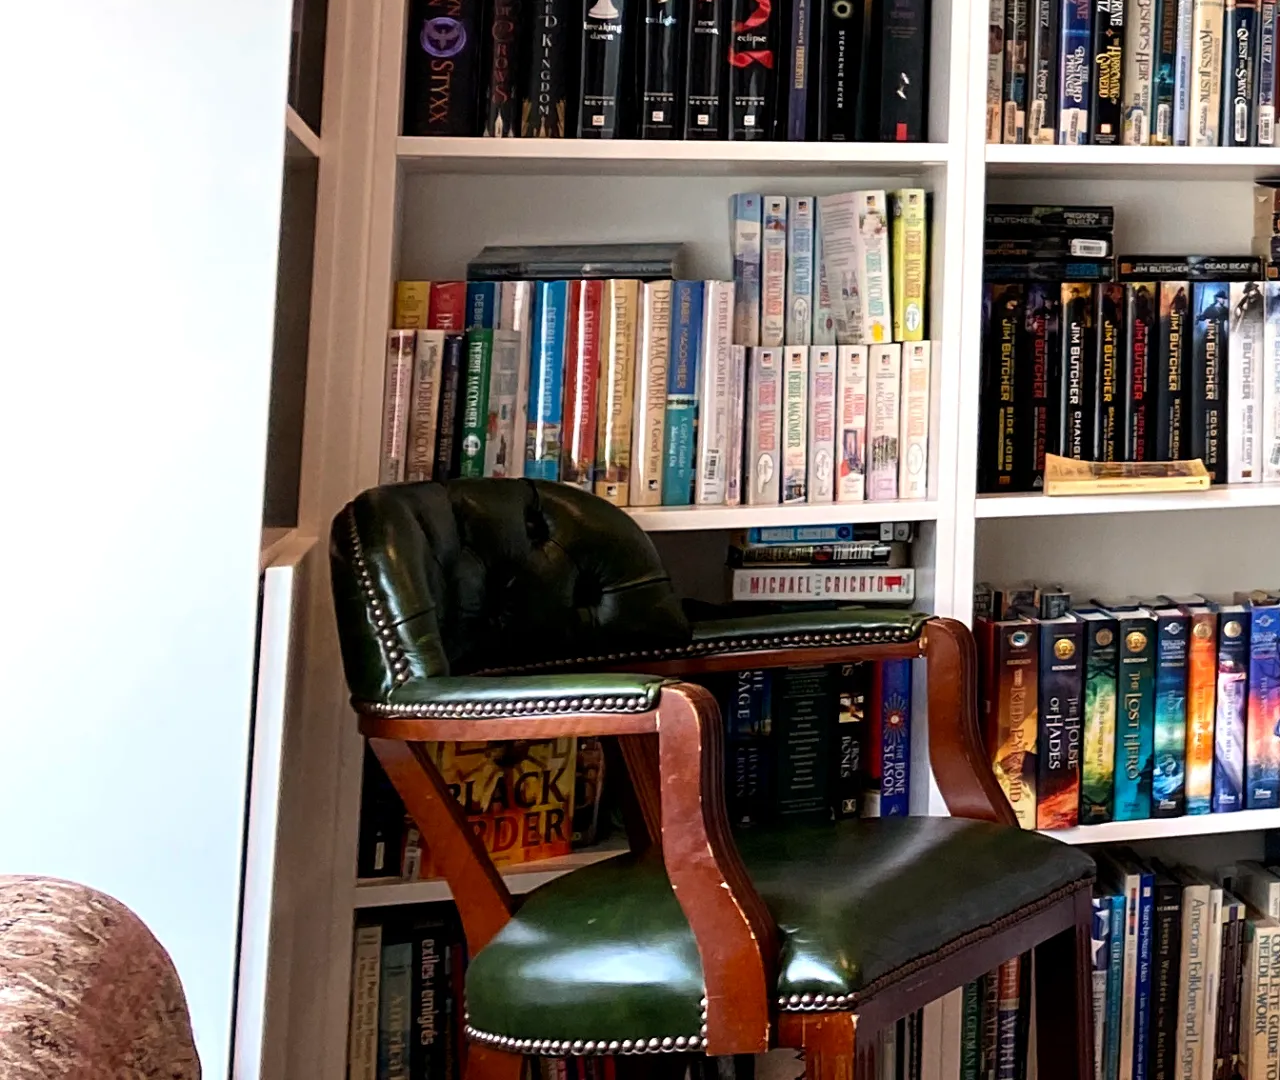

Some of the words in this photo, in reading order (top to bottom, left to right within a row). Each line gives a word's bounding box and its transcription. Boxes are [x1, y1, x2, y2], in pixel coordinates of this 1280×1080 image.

[583, 22, 622, 33] breaking
[737, 34, 768, 49] eclipse
[429, 60, 454, 124] STYXX
[538, 34, 554, 115] KINGDOM
[652, 289, 670, 337] DEBBIE
[716, 292, 729, 332] DEBBIE
[1070, 322, 1080, 344] JIM
[1103, 320, 1113, 342] JIM
[1169, 309, 1180, 331] JIM
[1206, 319, 1216, 341] JIM
[648, 338, 667, 411] MACOMBER
[715, 334, 727, 398] MACOMBER
[1000, 344, 1011, 402] BUTCHER
[1068, 346, 1080, 406] BUTCHER
[1103, 344, 1113, 402] BUTCHER
[1134, 342, 1145, 400] BUTCHER
[1168, 333, 1180, 392] BUTCHER
[750, 576, 812, 594] MICHAEL
[1049, 697, 1060, 713] OF
[1124, 693, 1142, 732] LOST
[1046, 715, 1063, 770] HADES
[1065, 717, 1080, 769] HOUSE
[1122, 733, 1141, 779] HERO
[883, 744, 895, 797] SEASON
[894, 762, 906, 795] BONE
[1188, 898, 1205, 958] American
[1187, 961, 1202, 1009] Folklore
[1255, 935, 1271, 1036] NEEDLEWORK
[1185, 1011, 1199, 1034] and
[1267, 1015, 1280, 1059] GUIDE
